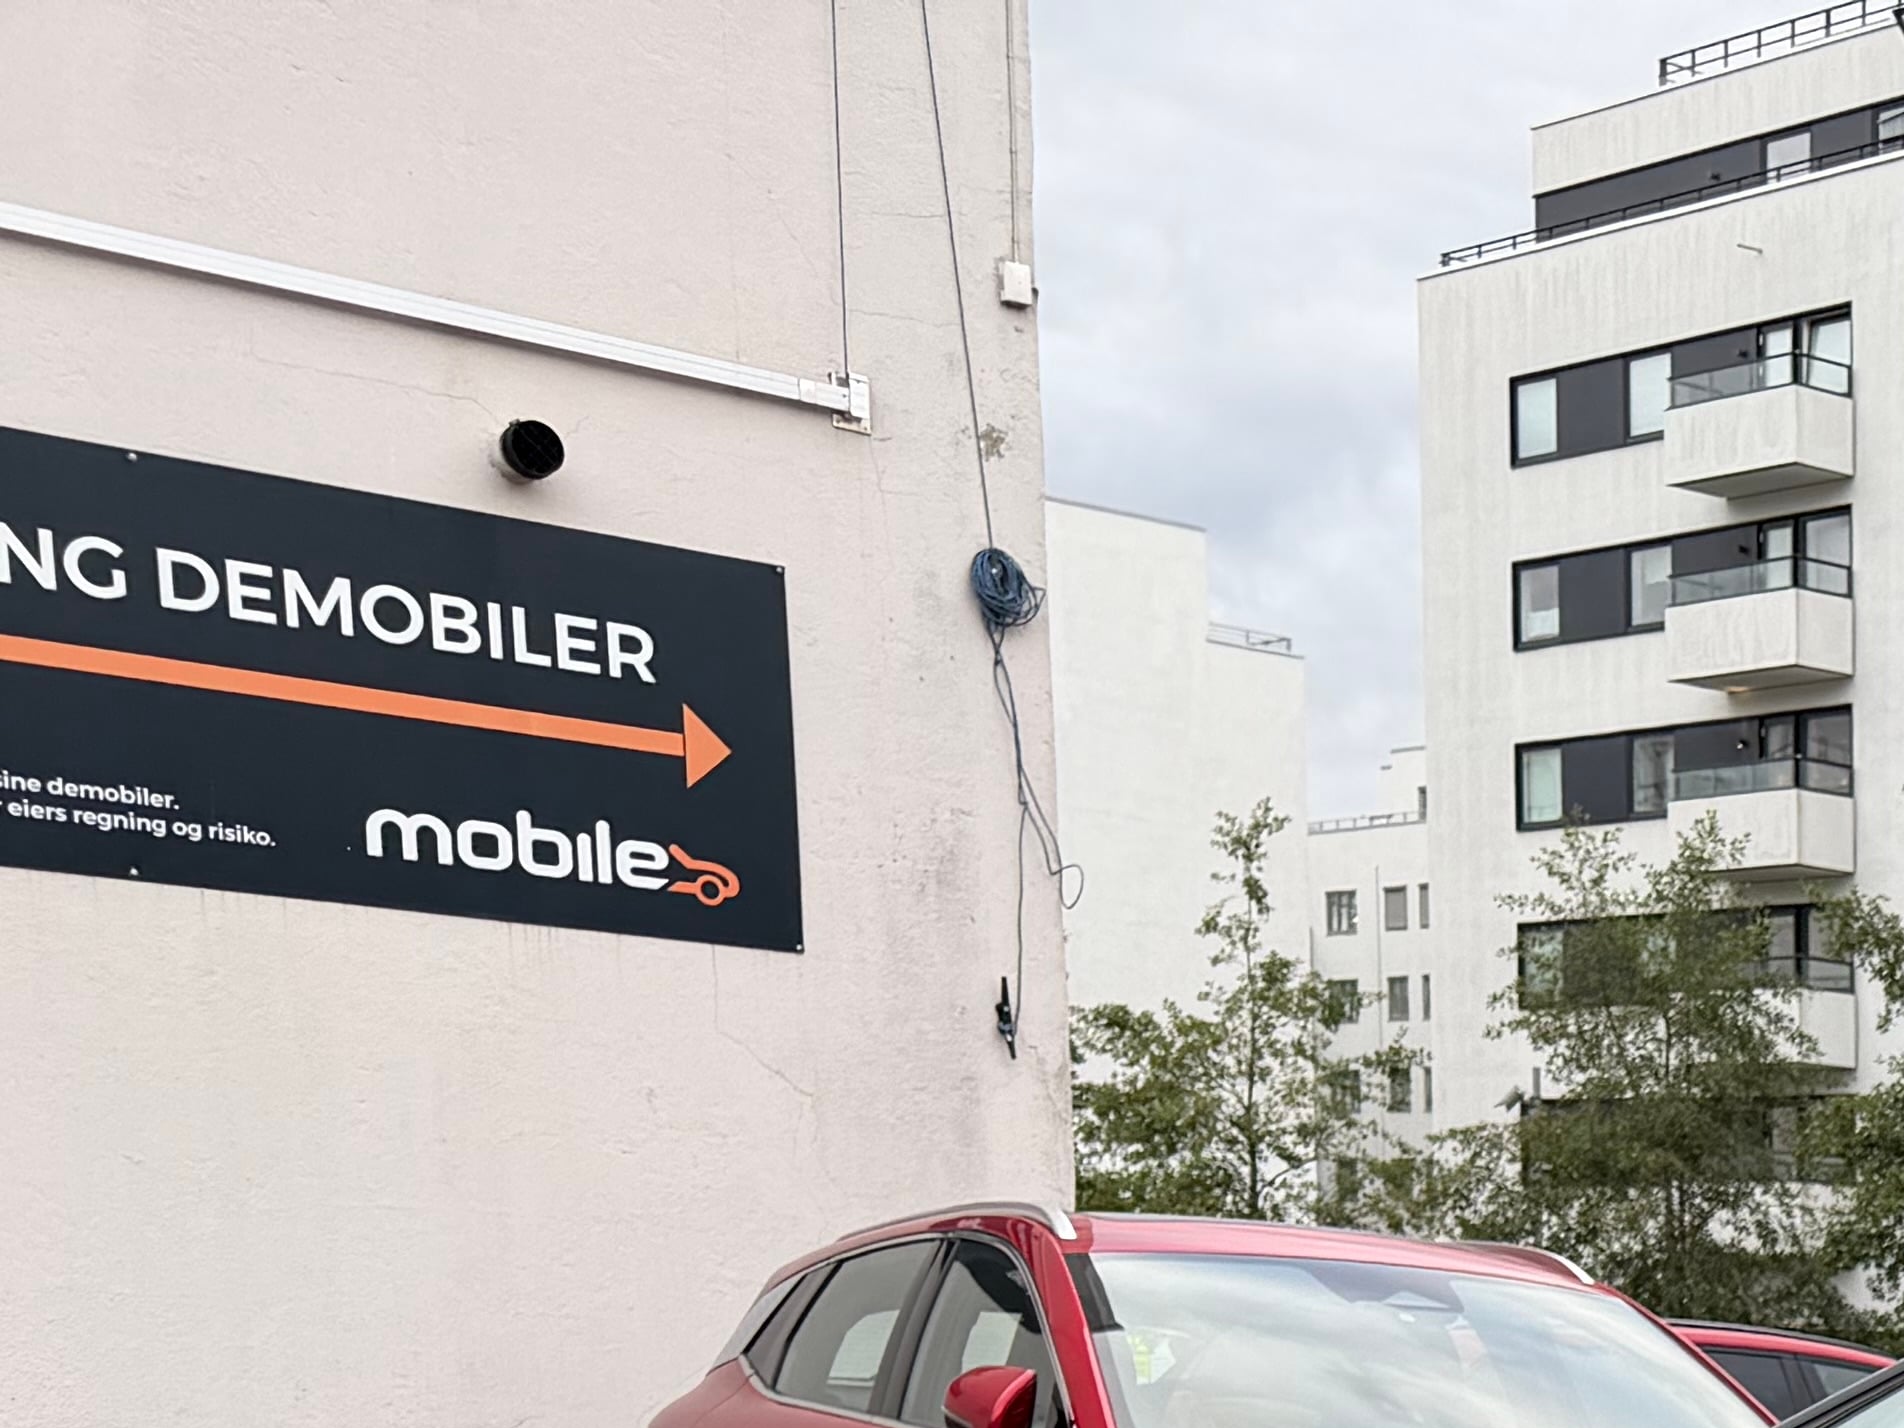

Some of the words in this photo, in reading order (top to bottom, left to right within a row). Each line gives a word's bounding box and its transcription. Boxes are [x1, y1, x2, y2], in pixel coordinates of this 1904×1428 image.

[0, 521, 127, 599] NG
[155, 547, 657, 684] DEMOBILER
[7, 799, 67, 822] eiers
[73, 810, 167, 837] regning
[172, 820, 202, 841] og
[208, 822, 276, 847] risiko.
[47, 777, 180, 810] demobiler.
[366, 809, 670, 891] mobile
